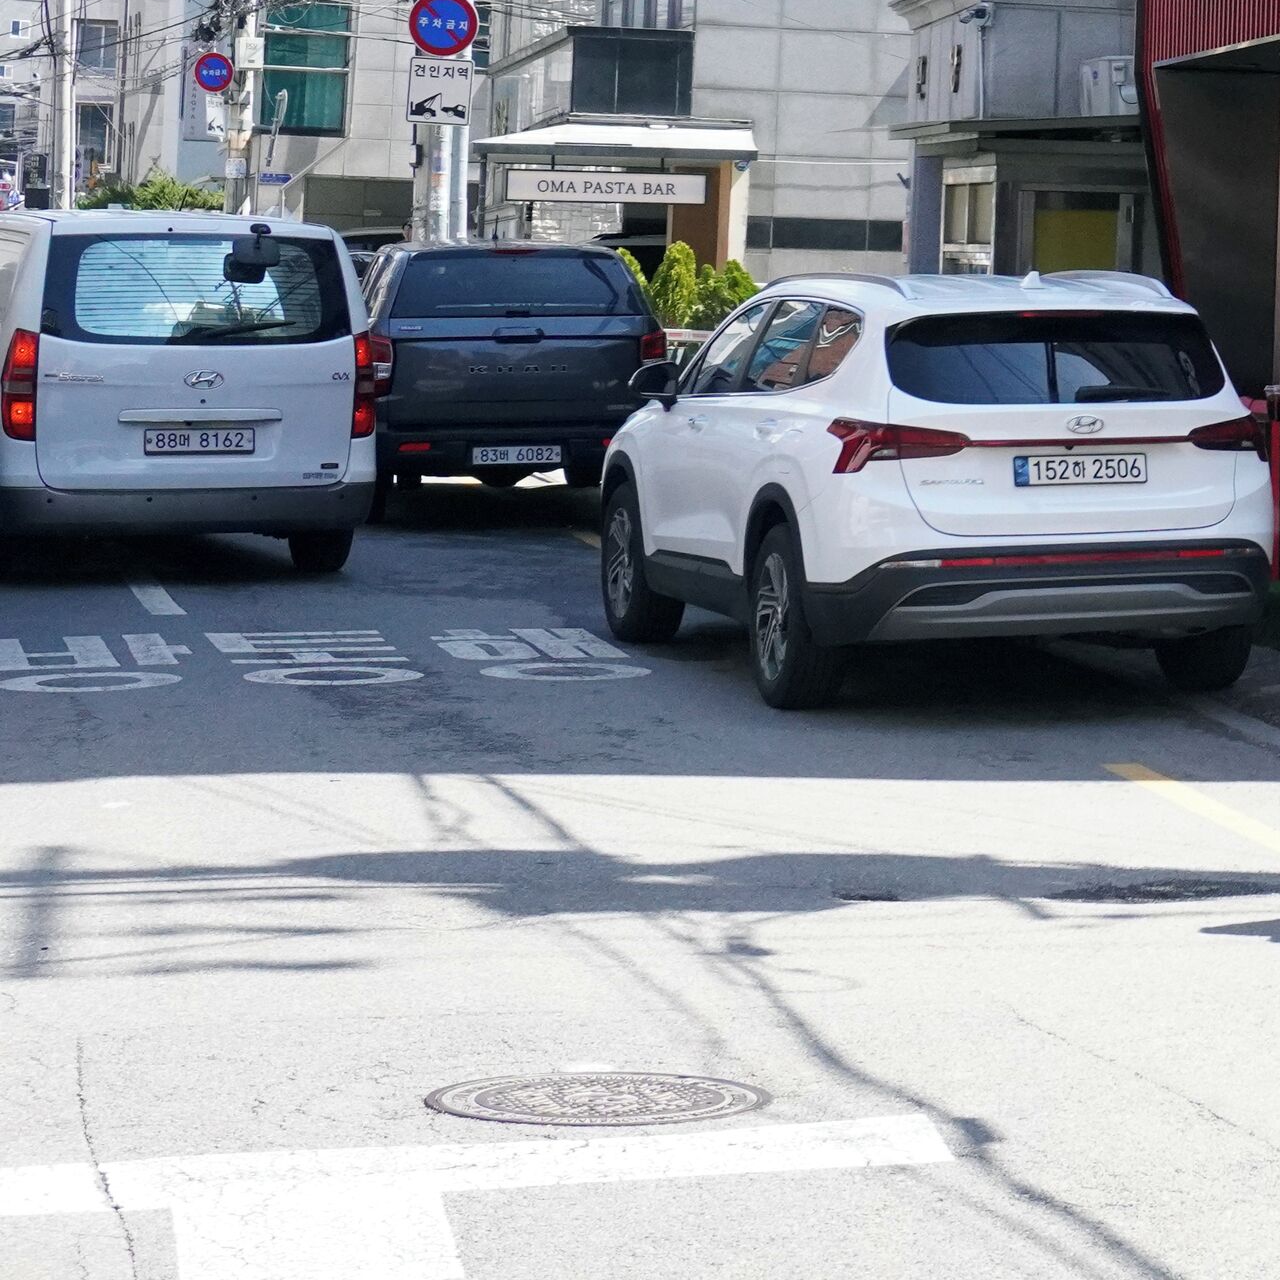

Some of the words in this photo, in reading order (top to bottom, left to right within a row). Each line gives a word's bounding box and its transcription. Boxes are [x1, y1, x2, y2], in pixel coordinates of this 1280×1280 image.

[418, 17, 468, 31] 주차금지
[414, 64, 469, 80] 견인지역
[537, 179, 577, 193] OMA
[583, 181, 637, 195] PASTA
[643, 182, 676, 196] BAR
[155, 432, 190, 449] 88머
[200, 432, 245, 449] 8162
[480, 449, 509, 463] 83버
[516, 447, 554, 462] 6082
[1032, 458, 1086, 481] 152하
[1092, 458, 1142, 480] 2506
